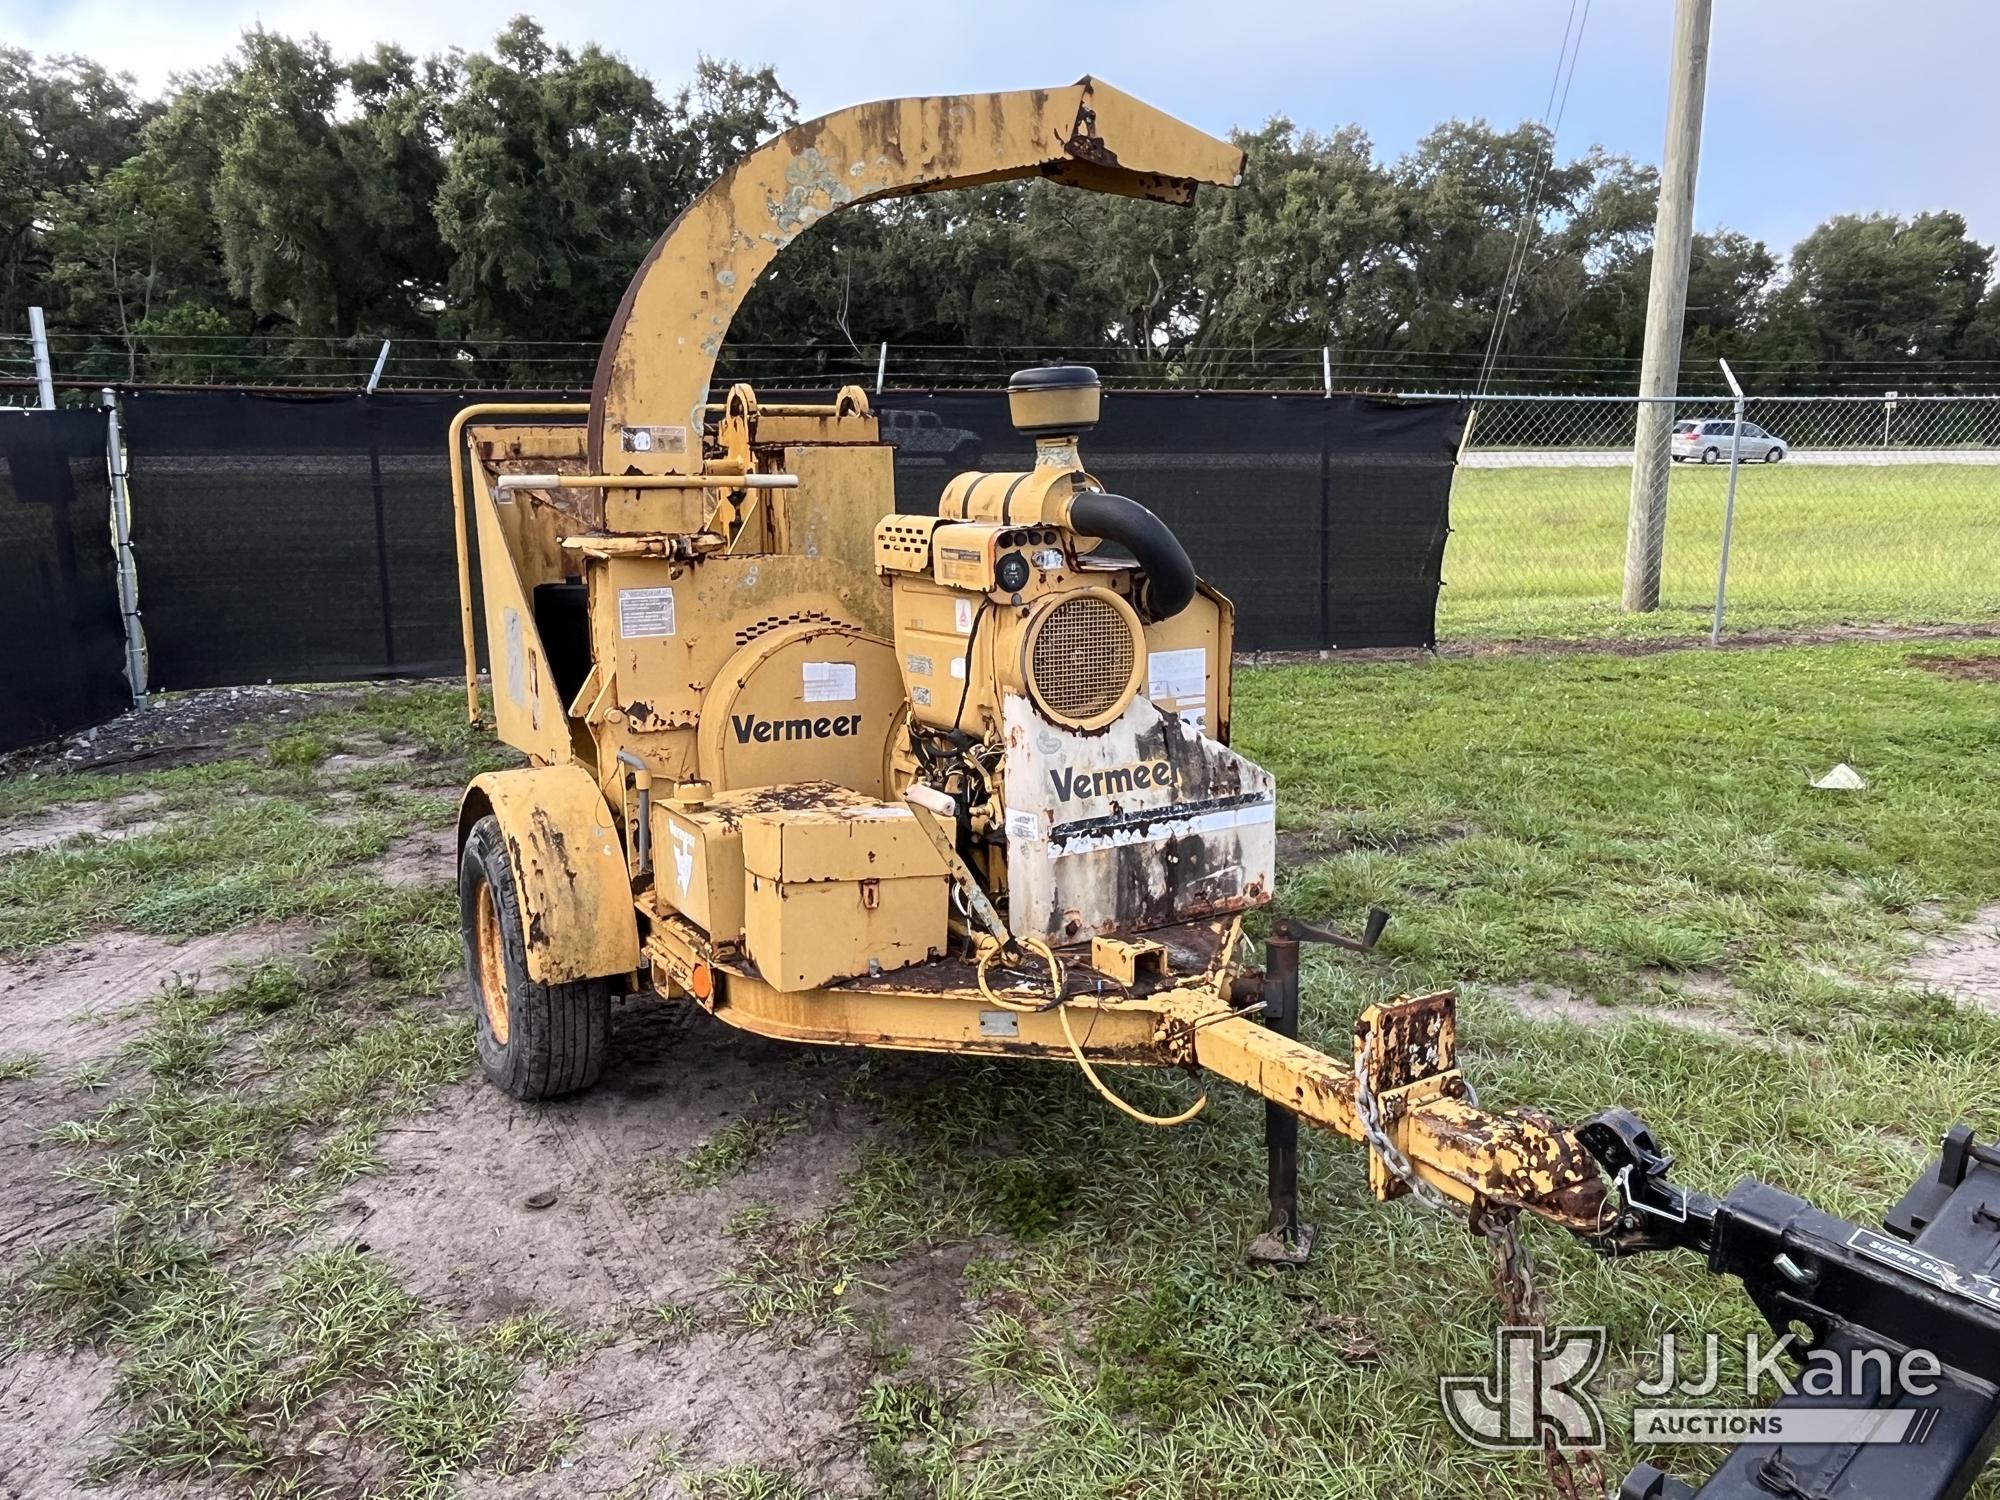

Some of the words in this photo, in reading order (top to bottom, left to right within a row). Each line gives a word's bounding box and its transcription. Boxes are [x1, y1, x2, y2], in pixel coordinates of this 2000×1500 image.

[731, 714, 862, 744] Vermeer
[1050, 761, 1180, 803] Vermeer
[1868, 1240, 1920, 1266] SUPER
